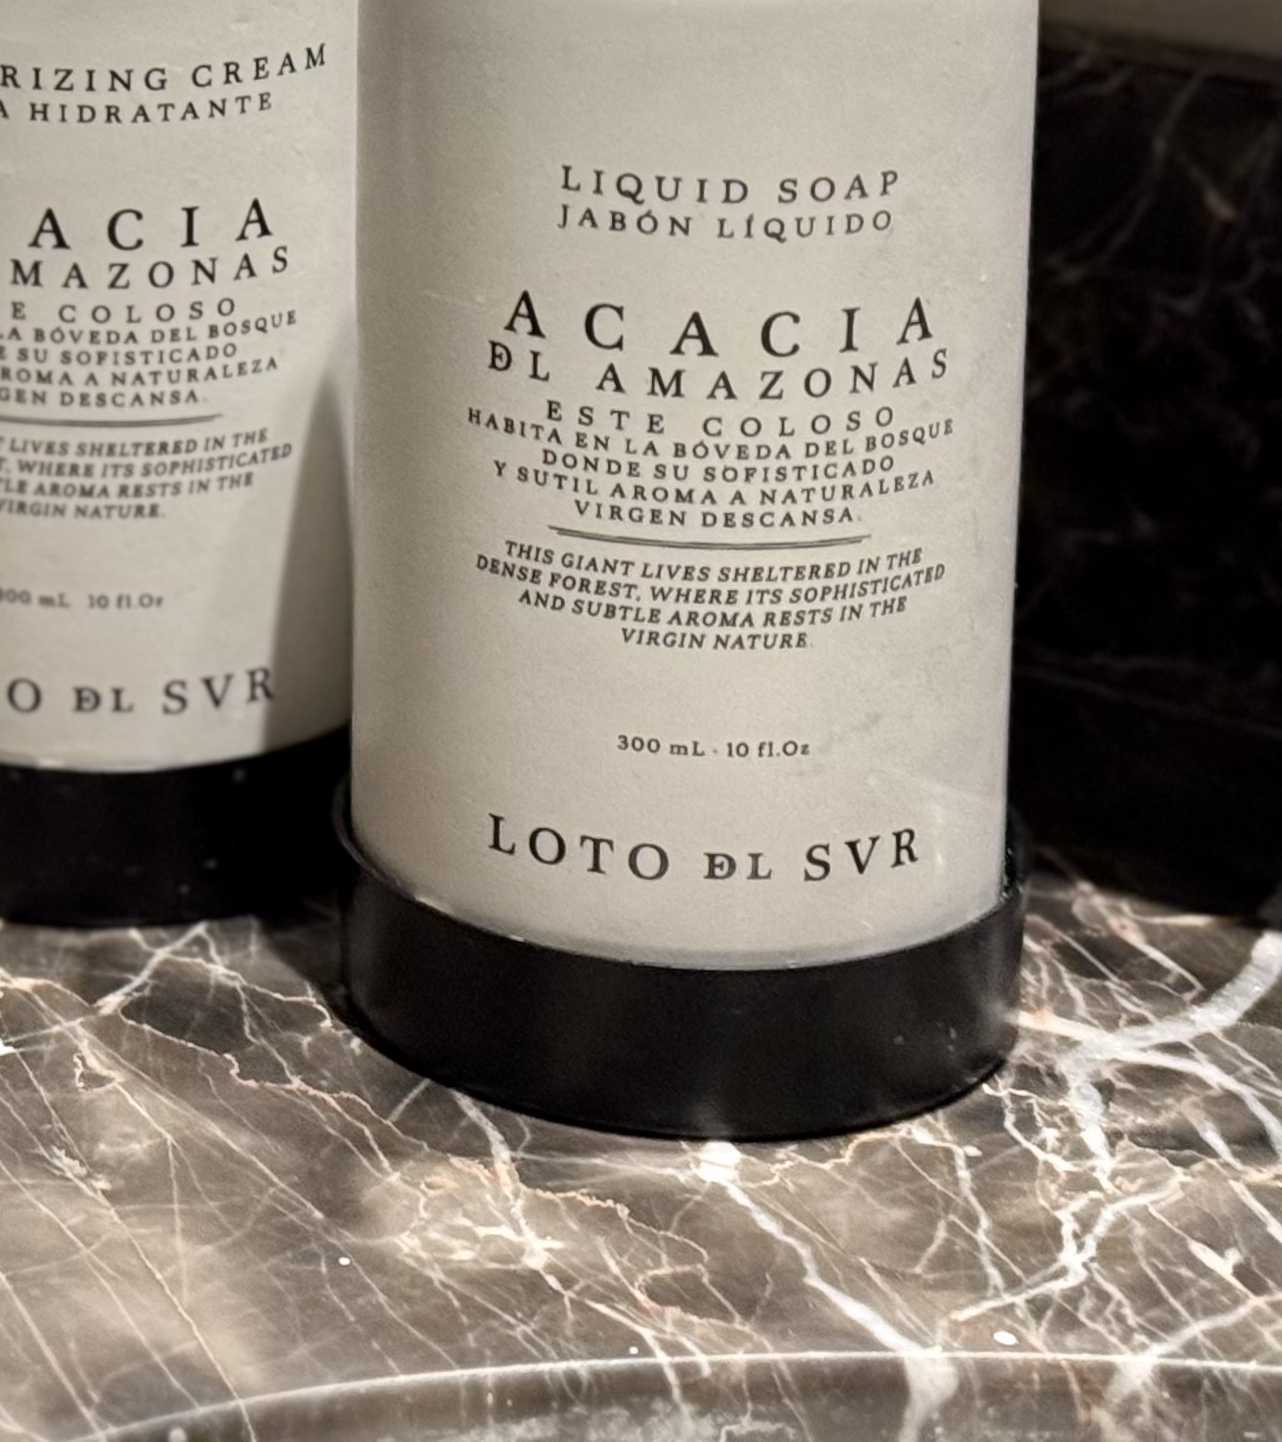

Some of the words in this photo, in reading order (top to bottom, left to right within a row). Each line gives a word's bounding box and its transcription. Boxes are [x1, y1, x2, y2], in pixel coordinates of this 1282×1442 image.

[192, 42, 327, 88] CREAM
[29, 91, 273, 124] HIDRATANTE
[560, 164, 749, 206] LIQUID
[777, 169, 899, 204] SOAP
[557, 203, 692, 237] JABÓN
[717, 210, 892, 244] LÍQUIDO
[34, 326, 138, 345] BÓVEDA
[151, 327, 197, 345] DEL
[208, 310, 297, 339] BOSQUE
[58, 297, 235, 324] COLOSO
[504, 289, 933, 358] ACACIA
[17, 348, 48, 363] SU
[60, 343, 237, 366] SOFISTICADO
[85, 372, 99, 387] A
[111, 356, 278, 387] NATURALEZA
[595, 347, 948, 401] AMAZONAS
[467, 407, 563, 445] HABITA
[574, 432, 610, 451] EN
[625, 438, 659, 457] LA
[673, 440, 791, 460] BÓVEDA
[805, 438, 854, 458] DEL
[865, 418, 954, 453] BOSQUE
[546, 400, 665, 435] ESTE
[702, 406, 893, 438] COLOSO
[10, 438, 70, 456] LIVES
[75, 439, 197, 457] SHELTERED
[204, 434, 226, 452] IN
[232, 427, 268, 448] THE
[18, 459, 94, 478] WHERE
[101, 463, 134, 478] ITS
[140, 443, 293, 477] SOPHISTICATED
[33, 481, 110, 498] AROMA
[117, 481, 182, 498] RESTS
[188, 478, 211, 495] IN
[217, 471, 254, 491] THE
[494, 460, 507, 477] Y
[517, 466, 598, 495] SUTIL
[610, 483, 717, 505] AROMA
[729, 490, 746, 506] A
[760, 469, 934, 506] NATURALEZA
[542, 448, 641, 478] DONDE
[653, 464, 689, 481] SU
[703, 455, 894, 483] SOFISTICADO
[574, 499, 687, 526] VIRGEN
[476, 554, 542, 585] DENSE
[650, 586, 738, 605] WHERE
[745, 588, 783, 605] ITS
[789, 563, 946, 604] SOPHISTICATED
[505, 540, 555, 565] THIS
[561, 552, 635, 577] GIANT
[641, 562, 711, 583] LIVES
[718, 561, 851, 583] SHELTERED
[857, 556, 881, 575] IN
[886, 547, 923, 570] THE
[519, 589, 566, 611] AND
[571, 598, 661, 624] SUBTLE
[667, 611, 755, 628] AROMA
[762, 608, 833, 627] RESTS
[839, 603, 864, 622] IN
[869, 595, 908, 618] THE
[622, 627, 707, 650] VIRGIN
[161, 667, 275, 715] SVR
[616, 734, 661, 754] 300
[669, 739, 706, 757] mL
[726, 741, 750, 759] 10
[487, 812, 671, 882] LOTO
[803, 827, 921, 883] SVR
